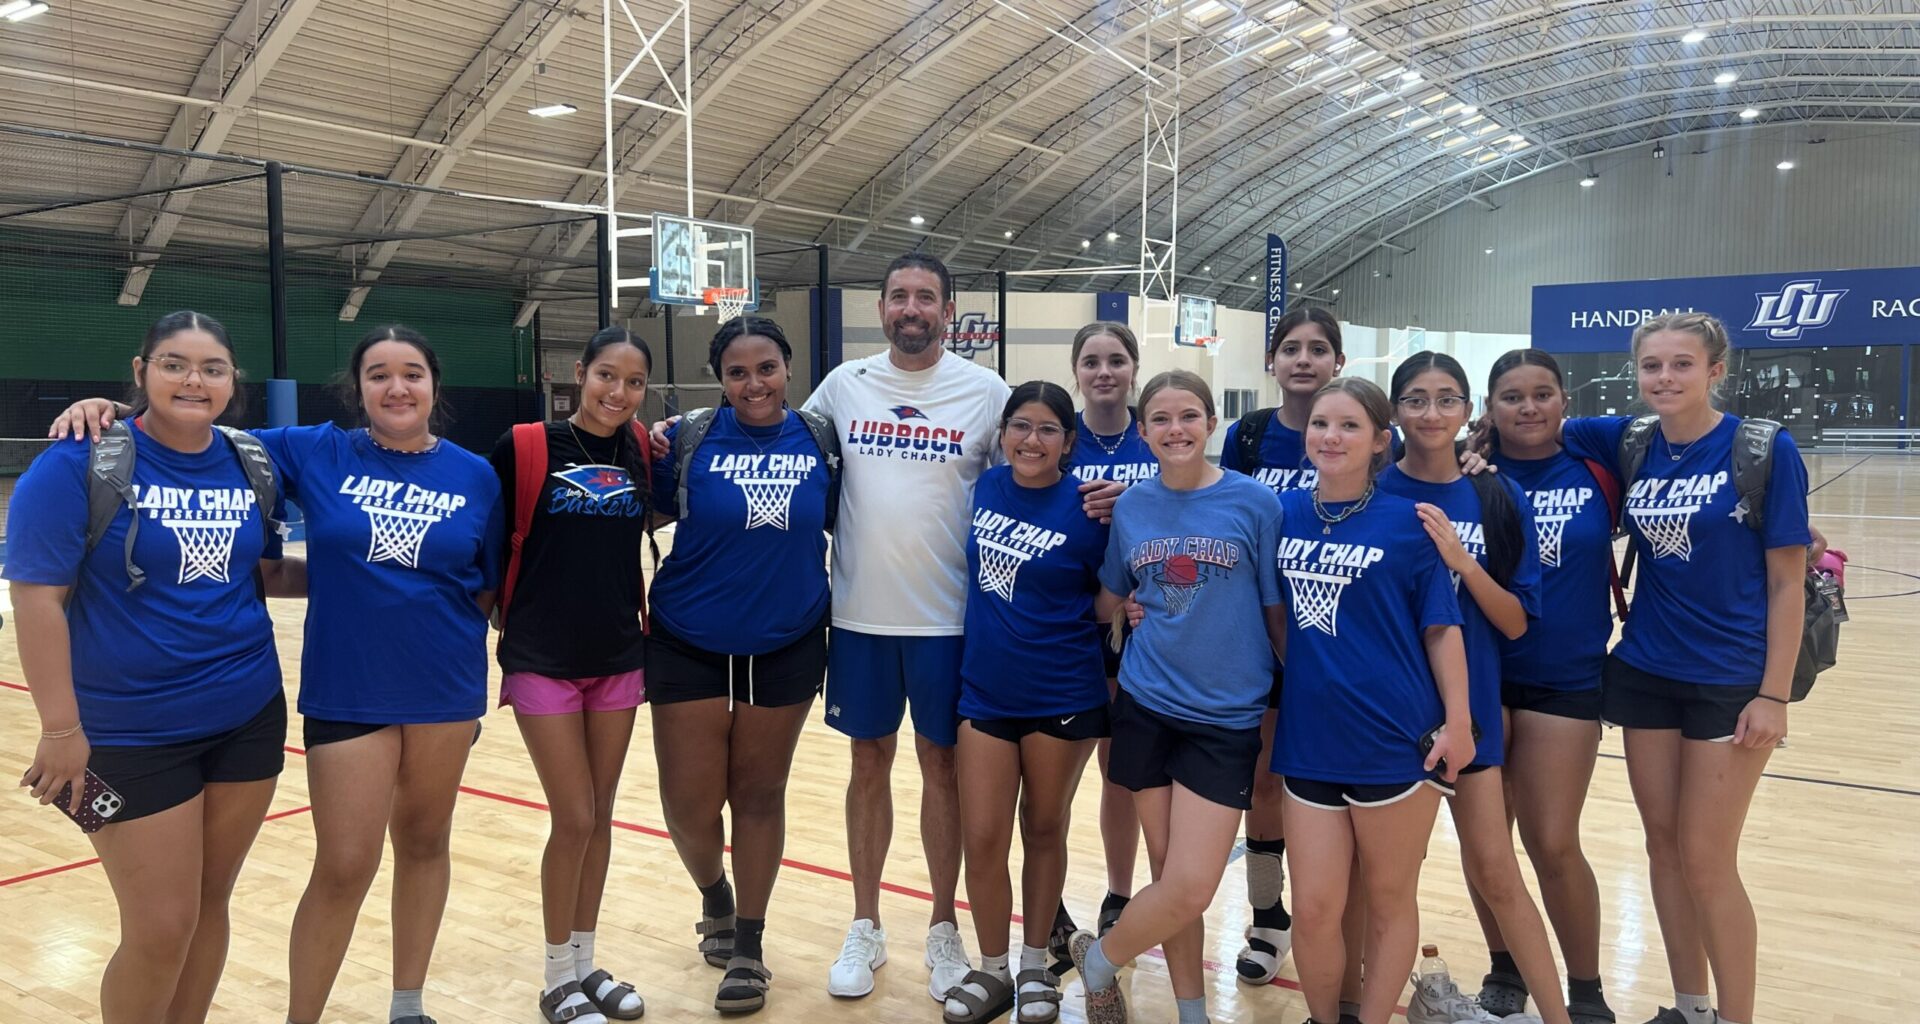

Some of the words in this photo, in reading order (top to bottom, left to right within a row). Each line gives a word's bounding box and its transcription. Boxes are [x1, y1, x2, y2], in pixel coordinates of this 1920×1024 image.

[1270, 248, 1281, 302] FITNESS
[1269, 307, 1281, 339] CEN
[1750, 282, 1842, 338] LCU
[848, 420, 965, 456] LUBBOCK
[709, 454, 766, 472] LADY
[768, 454, 817, 472] CHAP
[860, 446, 893, 458] LADY
[901, 450, 946, 463] CHAPS
[724, 470, 808, 480] BASKETBALL
[1072, 465, 1110, 482] ADY
[1252, 467, 1298, 487] ADY
[128, 484, 194, 509] LADY
[198, 488, 256, 511] CHAP
[339, 474, 405, 501] LADY
[403, 483, 466, 512] CHAP
[547, 486, 643, 517] Basketb
[1533, 487, 1593, 508] CHAP
[149, 508, 249, 520] BASKETBALL
[972, 507, 1017, 534] LADY
[1010, 521, 1067, 551] CHAP
[1450, 521, 1485, 544] HA
[1131, 538, 1180, 570] LADY
[1183, 536, 1240, 569] CHAP
[1277, 537, 1320, 561] ADY
[1318, 542, 1384, 568] CHAP
